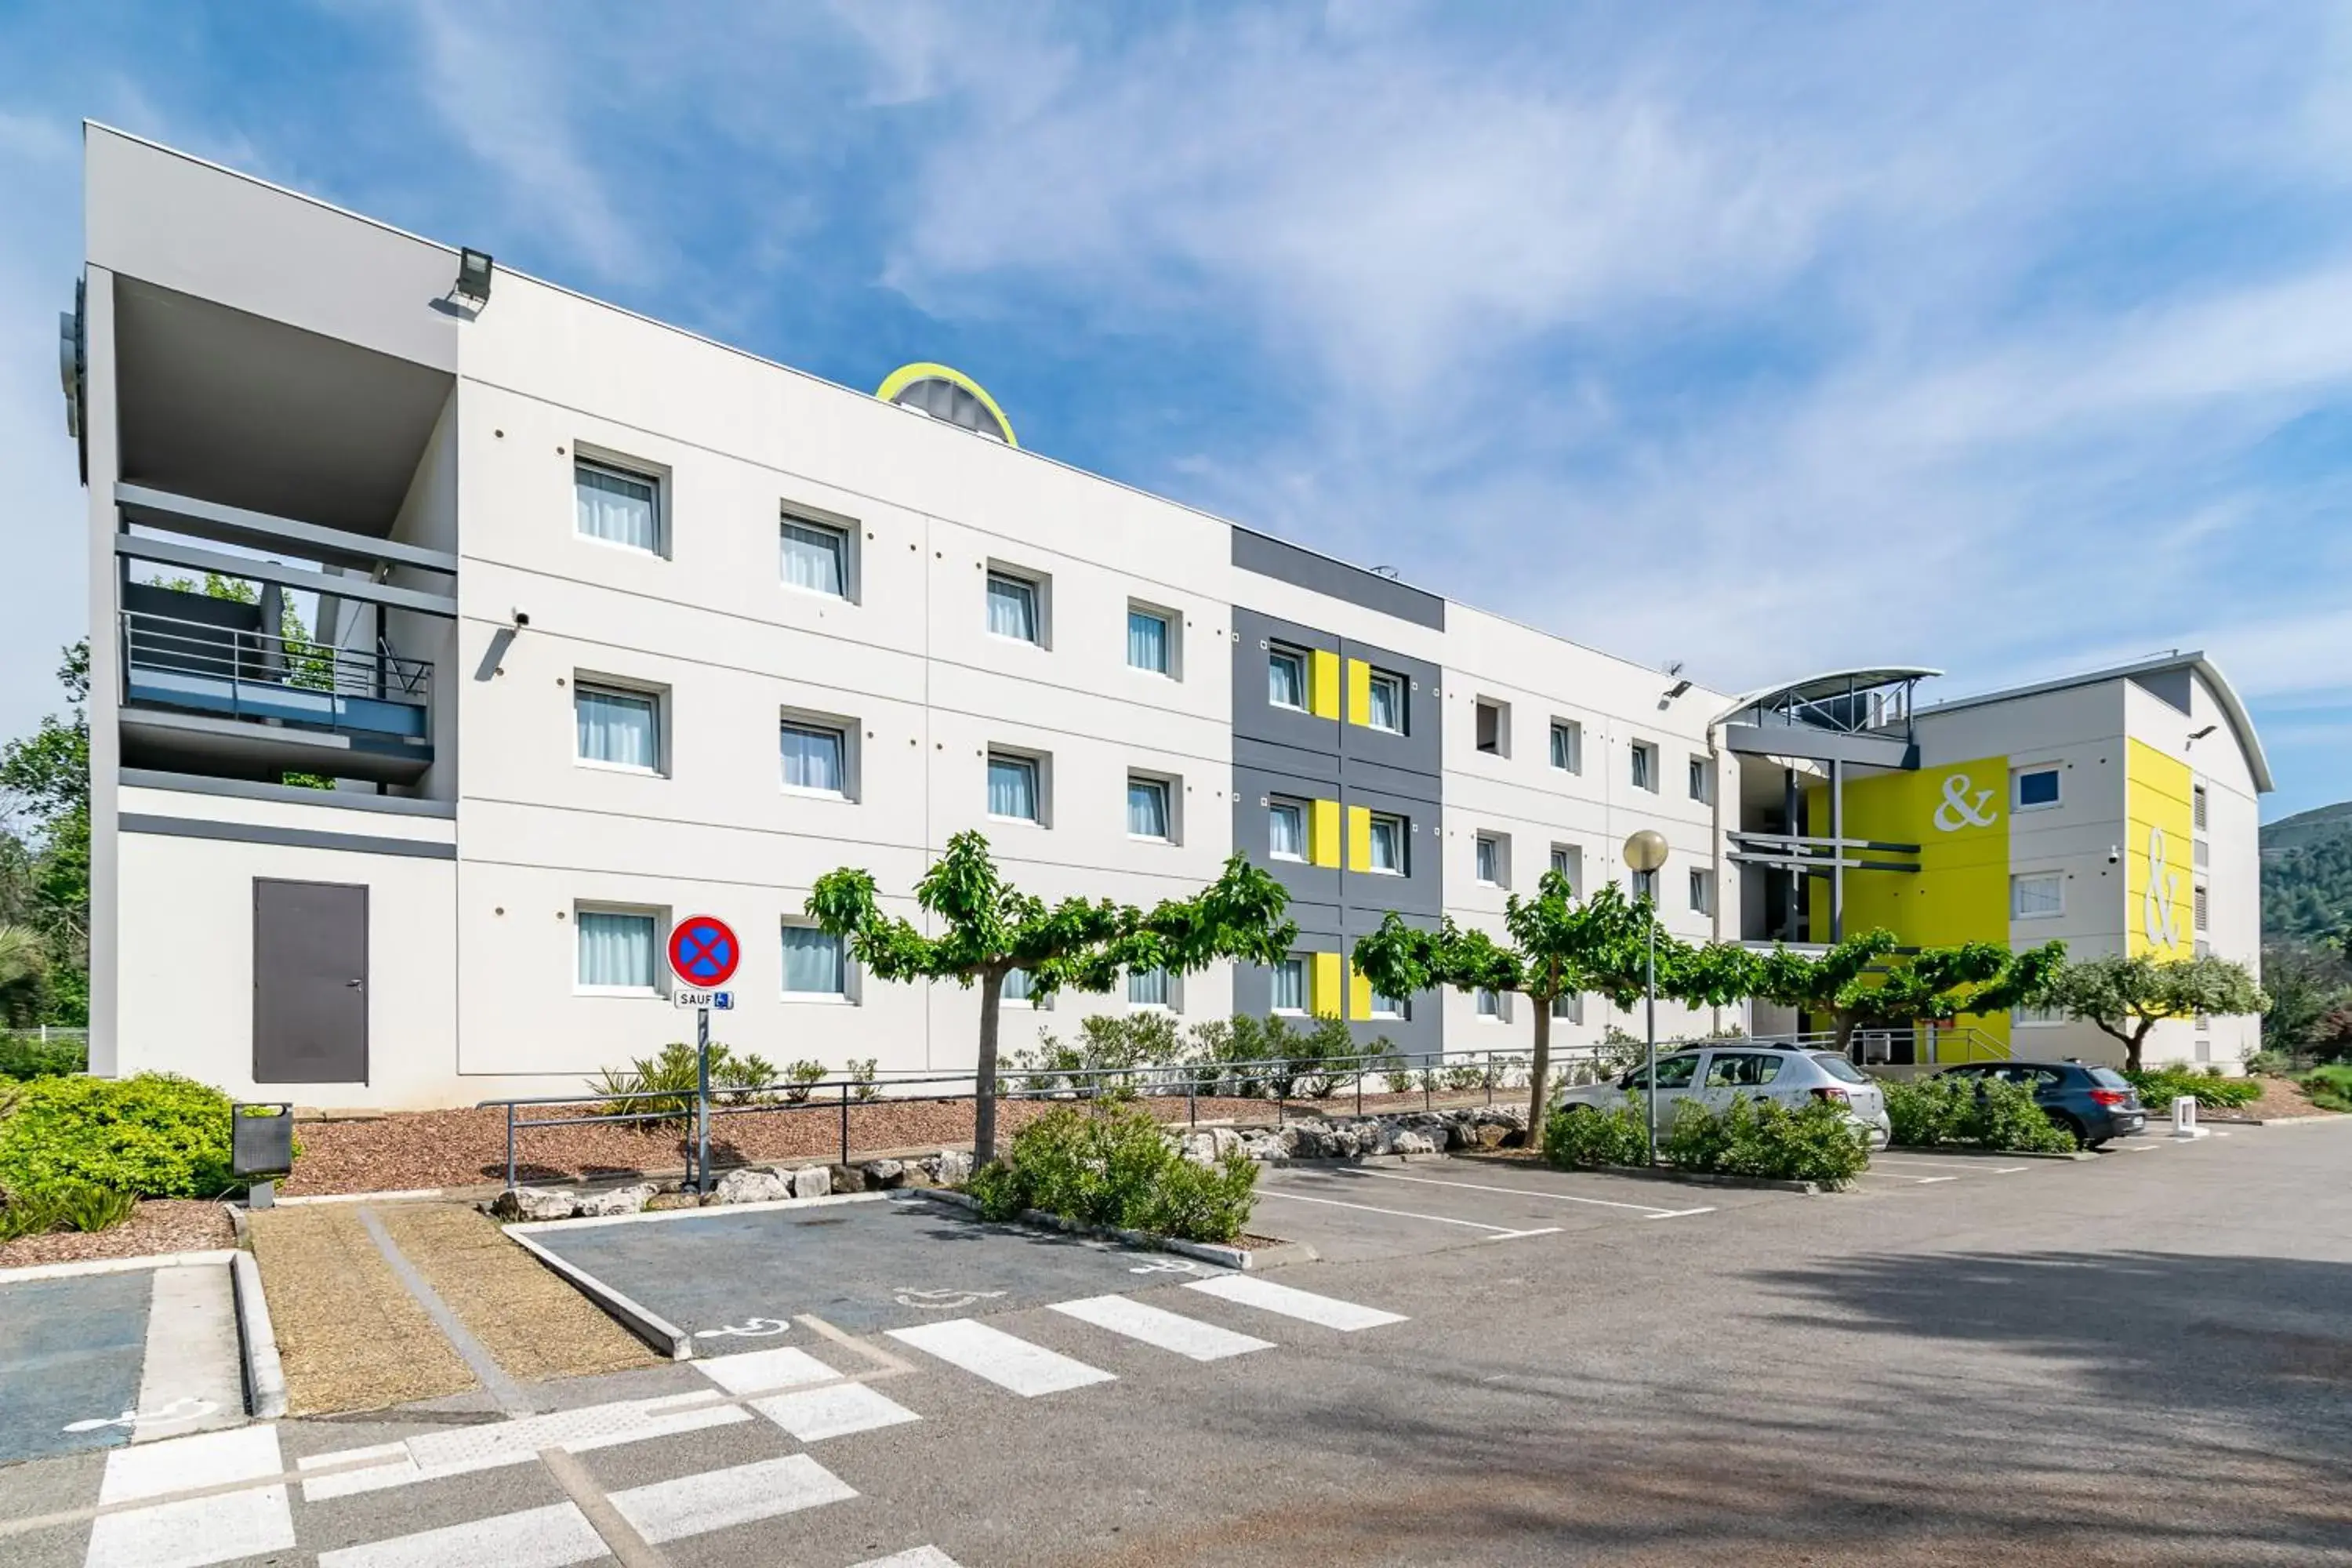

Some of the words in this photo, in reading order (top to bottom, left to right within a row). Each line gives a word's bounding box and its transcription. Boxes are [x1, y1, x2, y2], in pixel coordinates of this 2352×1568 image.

[1933, 773, 1998, 832] &
[2144, 827, 2180, 951] &
[681, 993, 712, 1004] SAUF
